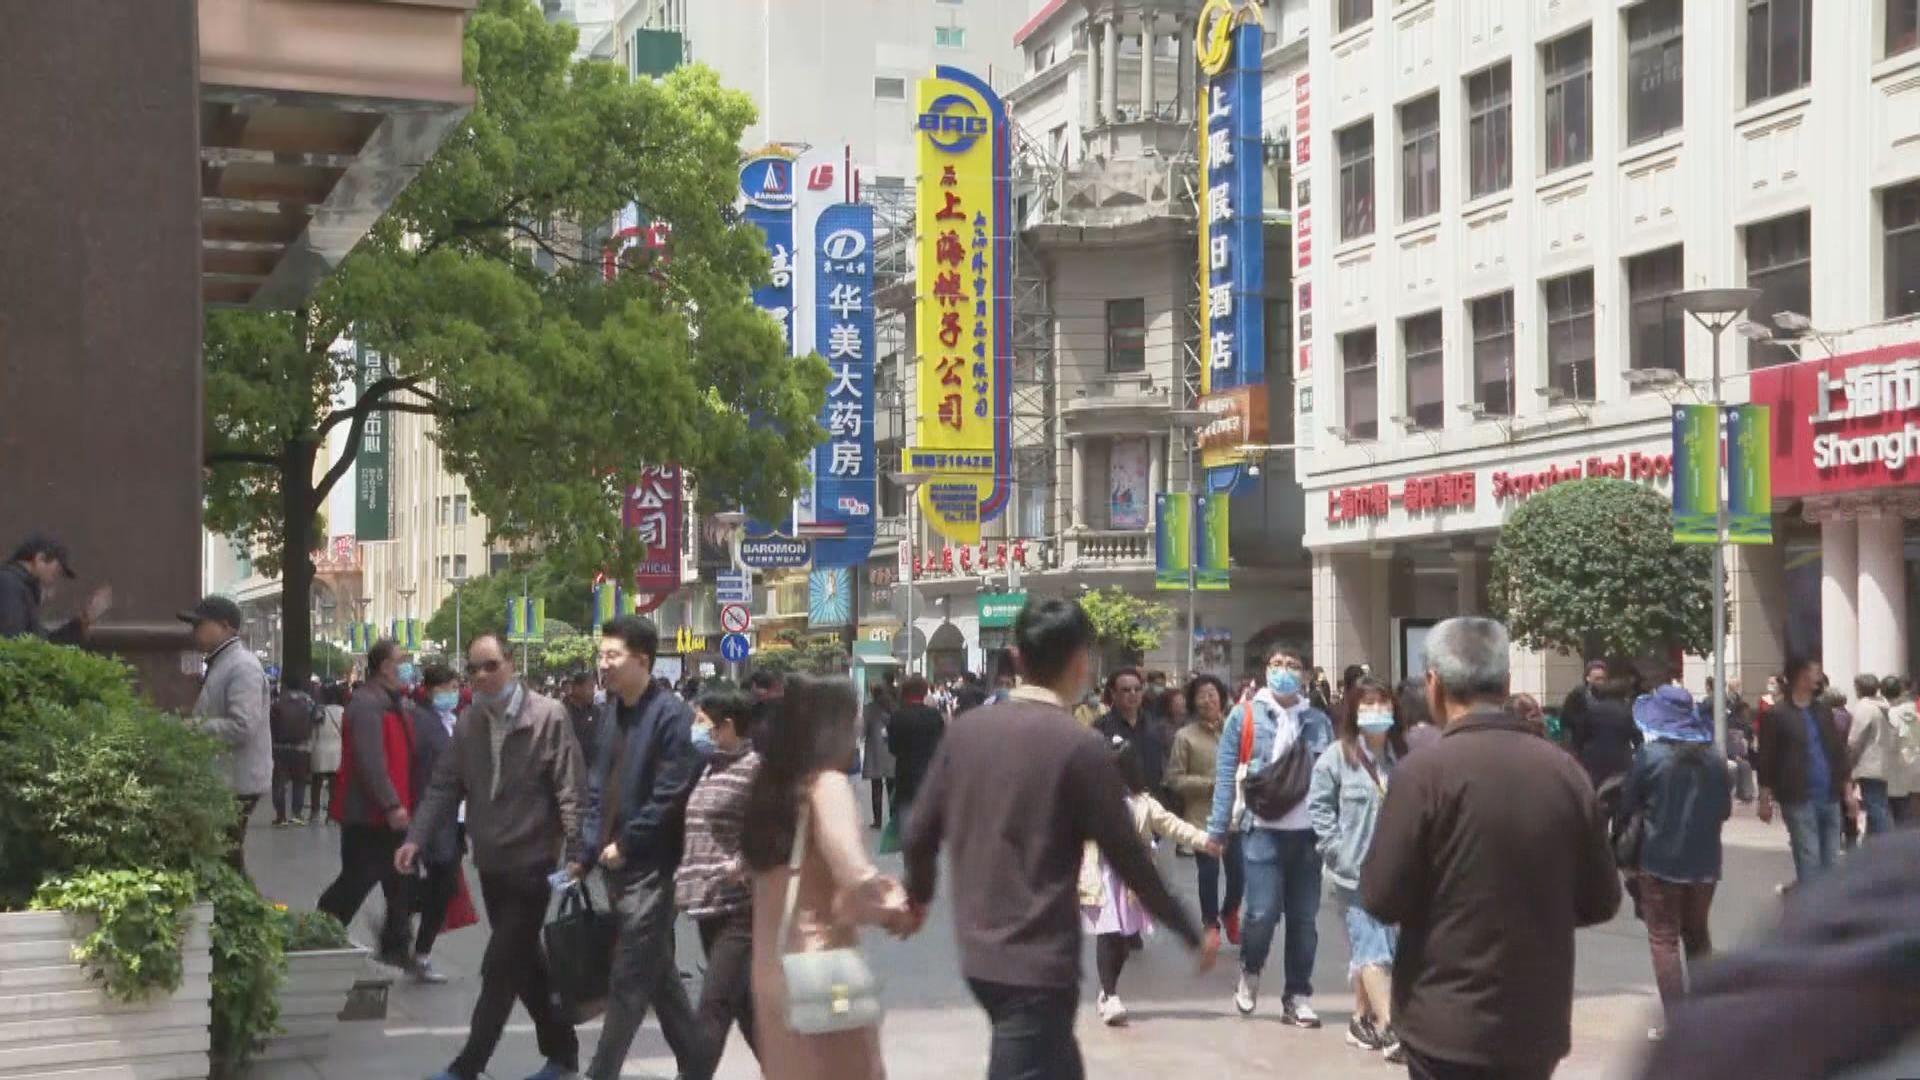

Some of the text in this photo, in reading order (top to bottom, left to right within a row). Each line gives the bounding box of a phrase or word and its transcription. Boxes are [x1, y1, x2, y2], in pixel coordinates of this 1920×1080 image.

[1207, 86, 1233, 370] 上服假日酒店
[829, 283, 863, 476] 华美大药房
[743, 543, 806, 553] BAROMON
